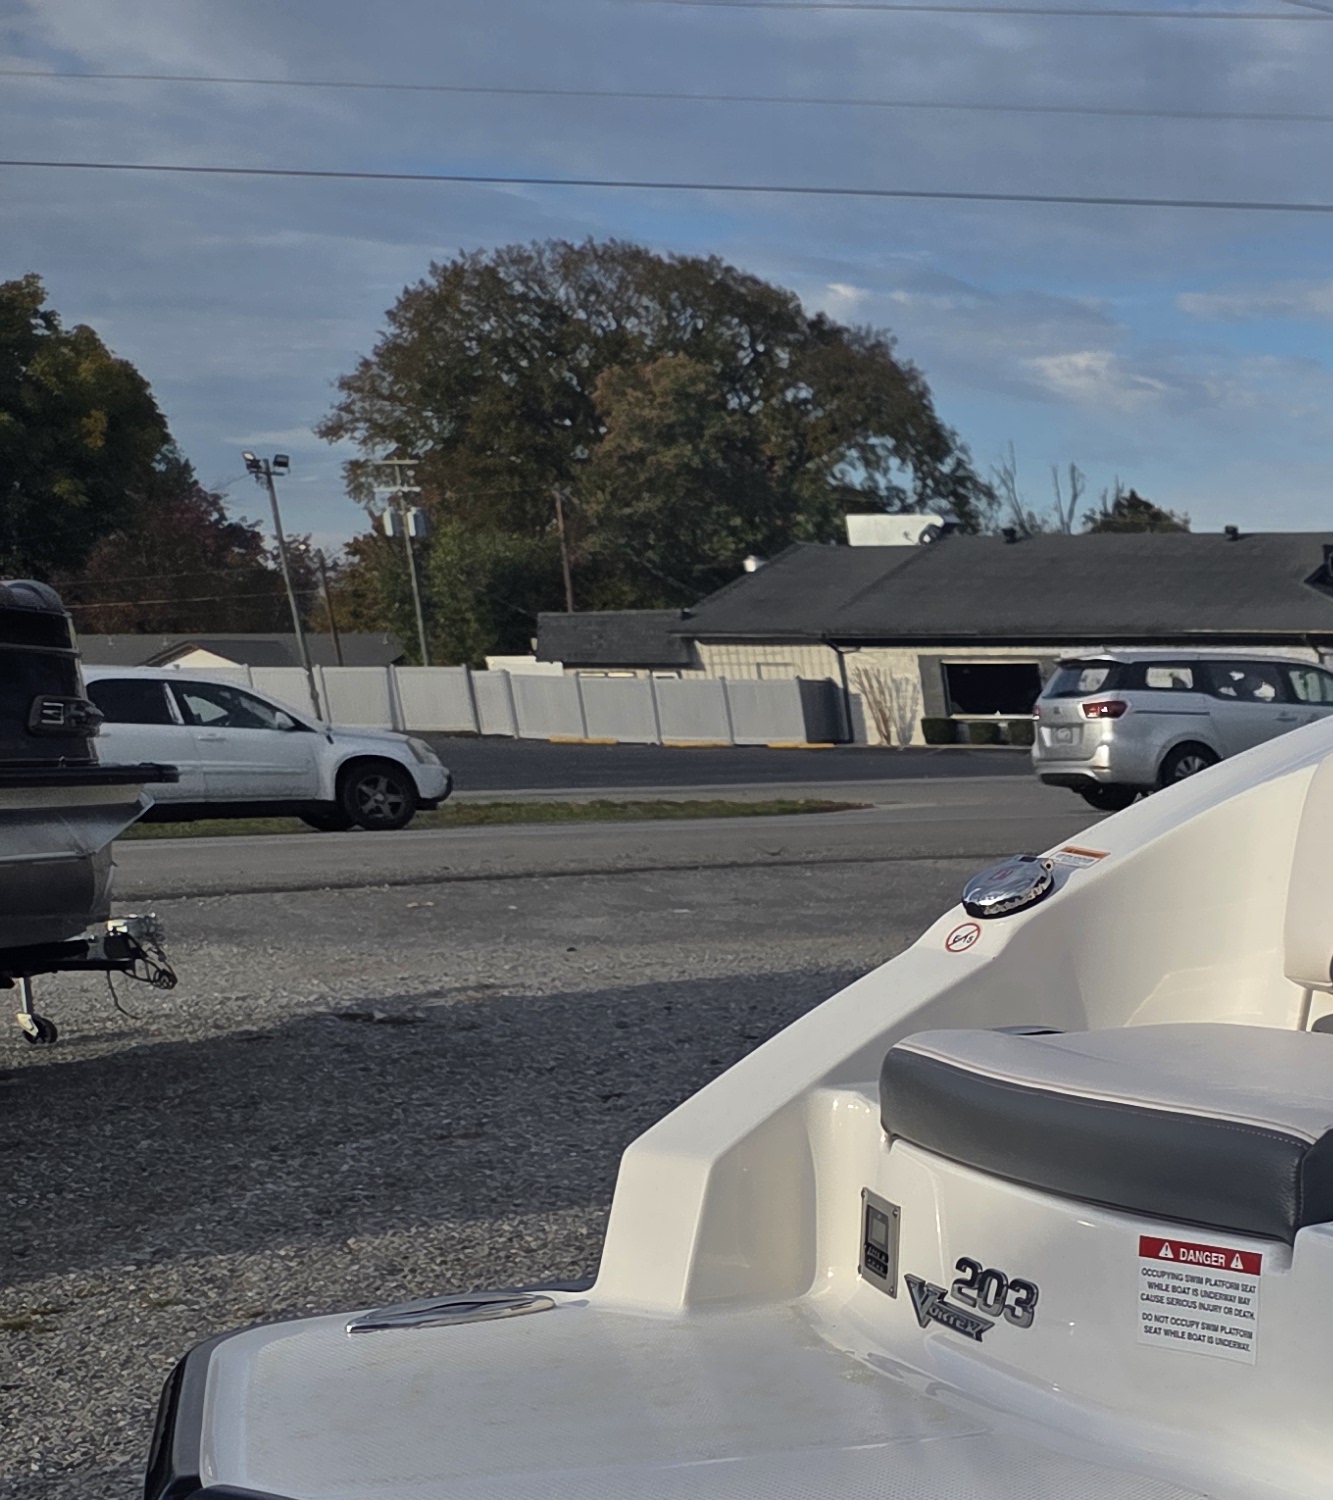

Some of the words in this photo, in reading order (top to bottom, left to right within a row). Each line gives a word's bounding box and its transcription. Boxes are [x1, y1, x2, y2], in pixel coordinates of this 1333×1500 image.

[1179, 1247, 1226, 1267] DANGER
[950, 1256, 1040, 1329] 203
[1146, 1280, 1169, 1292] WHILE
[1171, 1284, 1190, 1295] BOAT
[1192, 1288, 1198, 1296] IS
[1185, 1274, 1203, 1285] SWIM
[1205, 1277, 1239, 1291] PLATFORM
[1241, 1283, 1255, 1294] SEAT
[904, 1273, 995, 1342] VORTEX
[1140, 1292, 1164, 1304] CAUSE
[1166, 1296, 1196, 1309] SERIOUS
[1198, 1302, 1221, 1314] INJURY
[1223, 1306, 1232, 1315] OR
[1141, 1312, 1152, 1322] DO
[1154, 1314, 1168, 1324] NOT
[1170, 1317, 1199, 1330] OCCUPY
[1201, 1322, 1218, 1333] SWIM
[1220, 1325, 1252, 1339] PLATFORM
[1143, 1324, 1161, 1335] SEAT
[1163, 1328, 1185, 1340] WHILE
[1187, 1332, 1205, 1343] BOAT
[1207, 1336, 1213, 1345] IS
